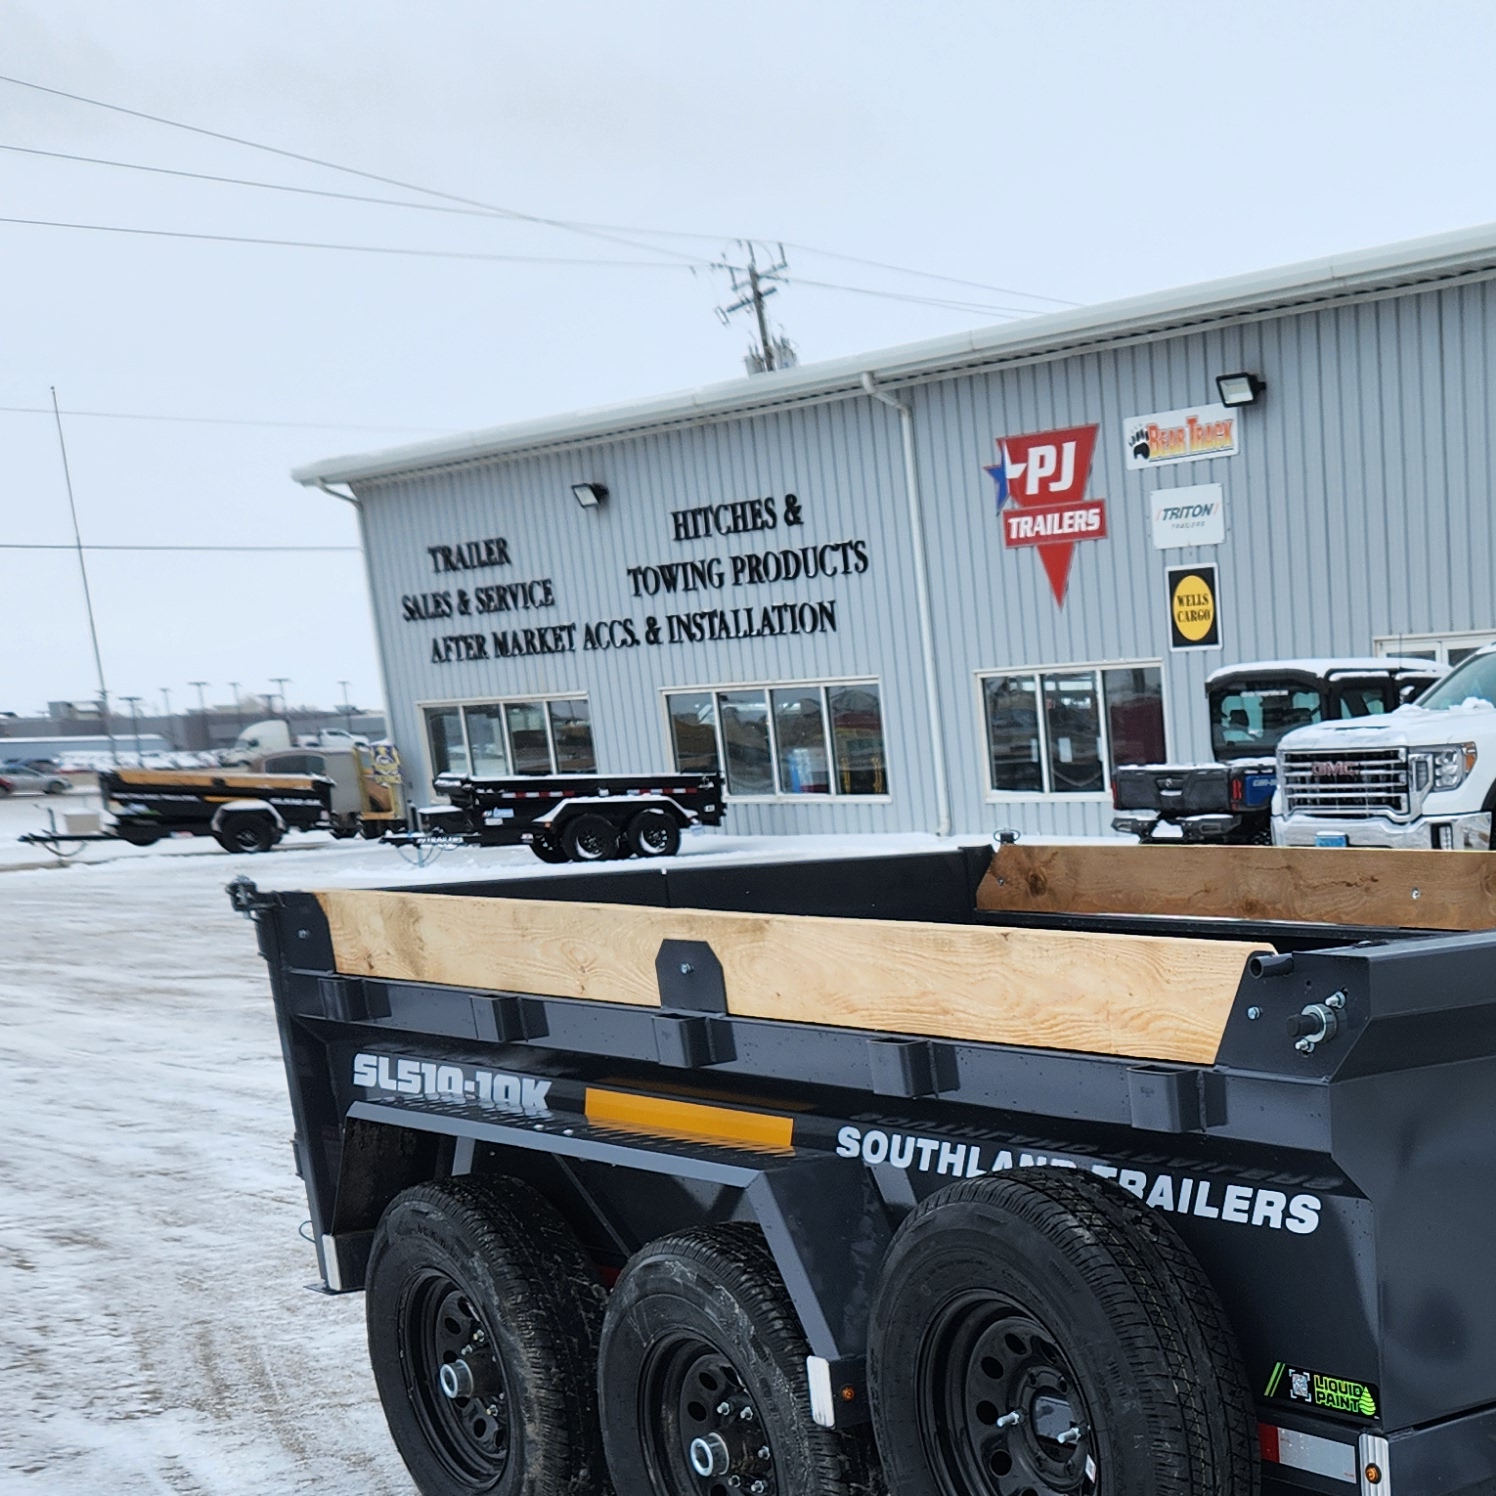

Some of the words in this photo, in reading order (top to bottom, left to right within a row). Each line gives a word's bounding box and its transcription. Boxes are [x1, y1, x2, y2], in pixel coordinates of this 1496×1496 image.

[1025, 440, 1077, 496] PJ
[671, 497, 778, 542] HITCHES
[784, 493, 804, 527] &
[1007, 507, 1101, 540] TRAILERS
[1162, 503, 1214, 521] TRITON
[427, 537, 513, 574] TRAILER
[627, 557, 726, 597] TOWING
[729, 539, 869, 587] PRODUCTS
[401, 591, 454, 623] SALES
[457, 588, 474, 617] &
[474, 578, 556, 615] SERVICE
[1177, 593, 1209, 607] WELLS
[1177, 608, 1211, 623] CARGO
[431, 633, 490, 664] AFTER
[492, 622, 577, 658] MARKET
[583, 618, 641, 651] ACCS.
[645, 615, 663, 646] &
[666, 600, 838, 644] INSTALLATION
[1311, 761, 1360, 777] GMC
[836, 1125, 1077, 1179] SOUTHLA
[1313, 1374, 1364, 1399] LIQUID
[1314, 1390, 1360, 1413] PAINT
